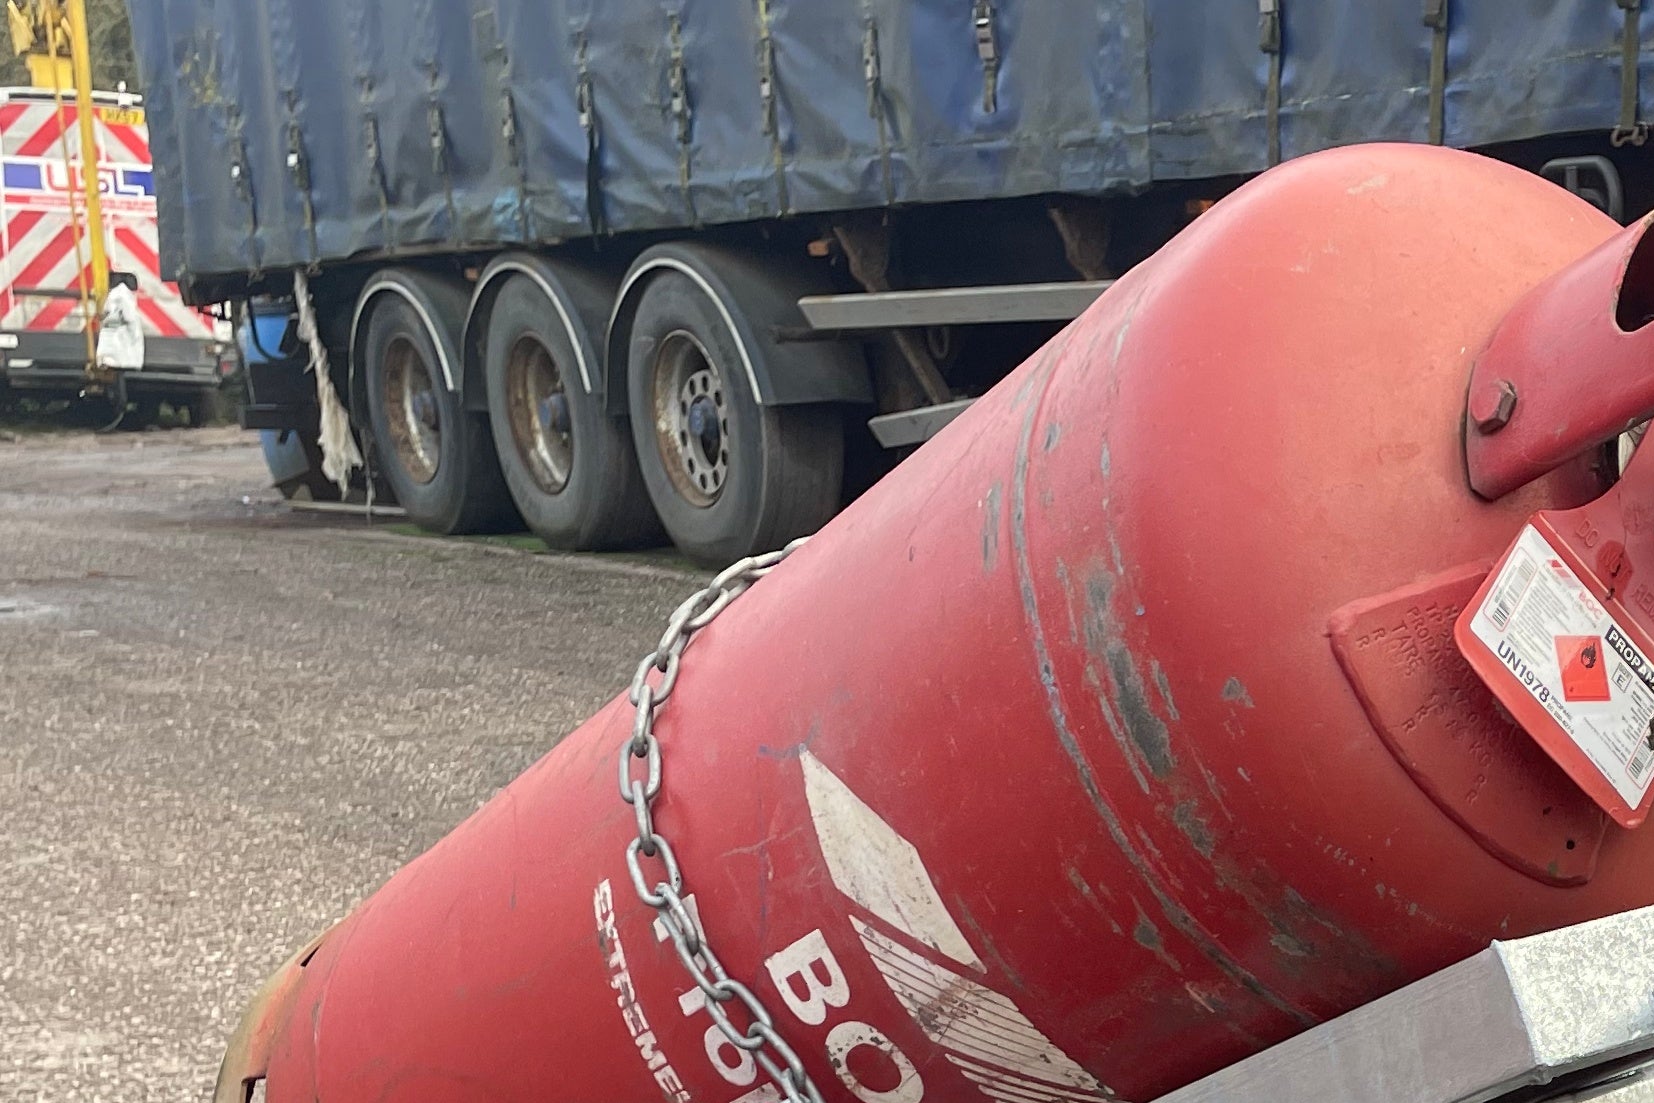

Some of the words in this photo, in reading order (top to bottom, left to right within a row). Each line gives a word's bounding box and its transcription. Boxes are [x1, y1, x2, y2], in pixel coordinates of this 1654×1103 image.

[1578, 590, 1603, 619] BOC
[1497, 640, 1550, 703] UN1978
[1616, 675, 1625, 685] E
